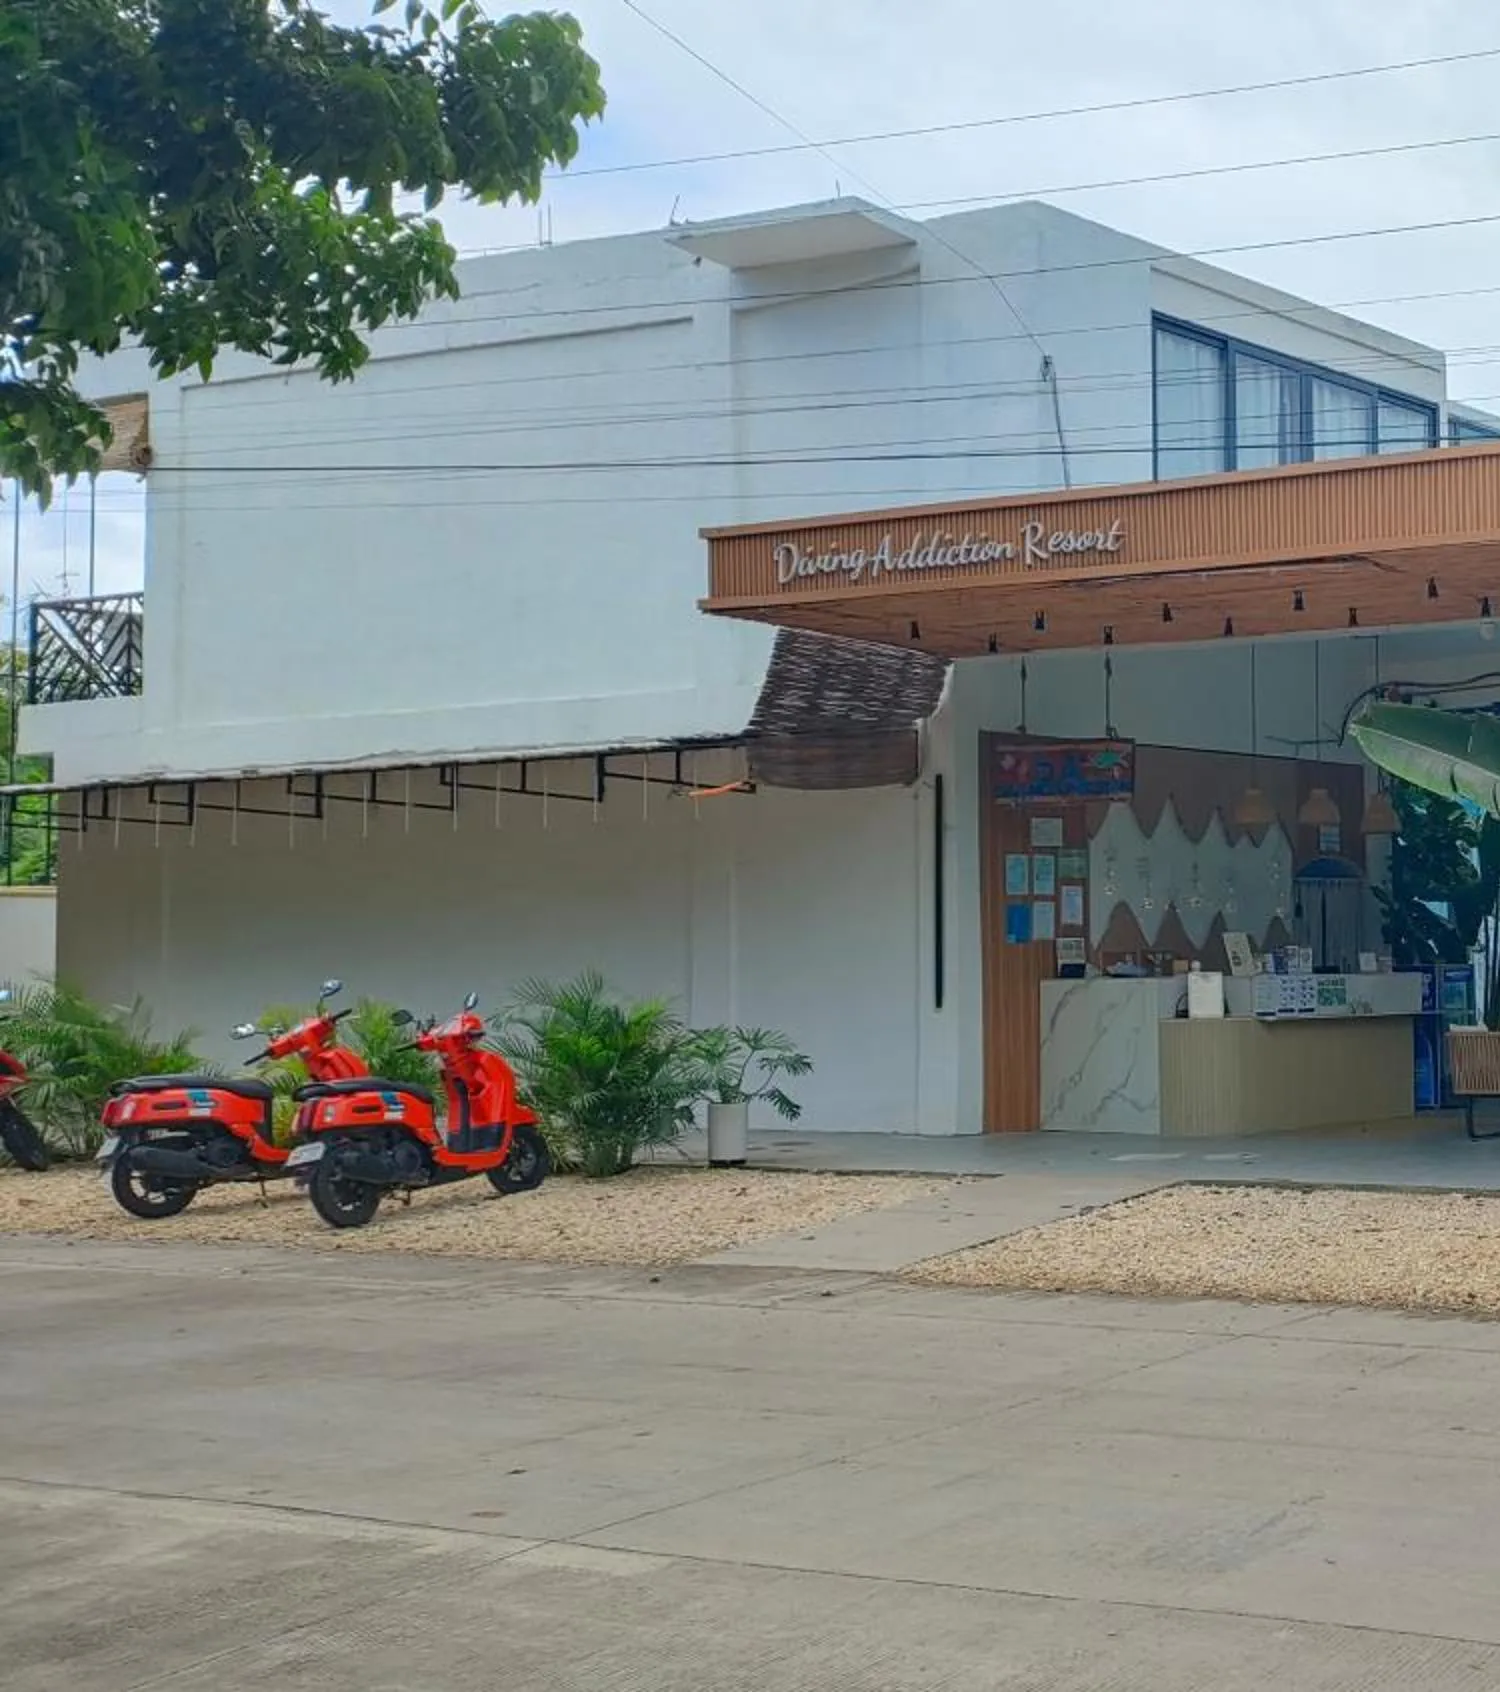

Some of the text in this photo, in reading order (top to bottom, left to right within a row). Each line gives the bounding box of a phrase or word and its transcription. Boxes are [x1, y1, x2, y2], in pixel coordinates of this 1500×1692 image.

[774, 518, 1127, 584] Diving Addiction Resort
